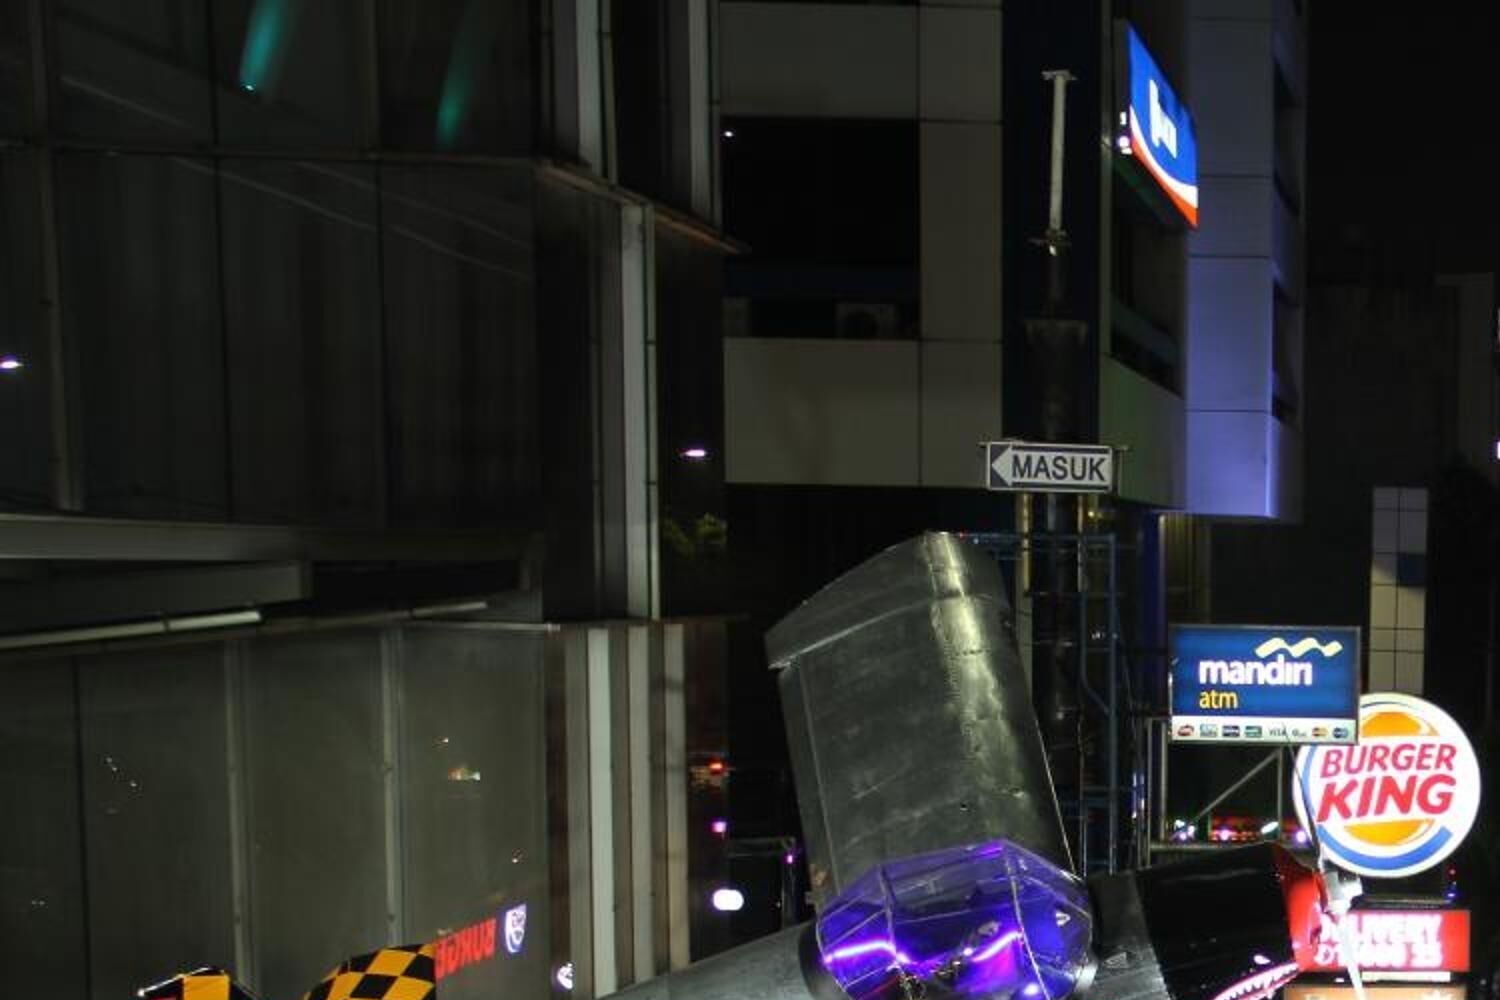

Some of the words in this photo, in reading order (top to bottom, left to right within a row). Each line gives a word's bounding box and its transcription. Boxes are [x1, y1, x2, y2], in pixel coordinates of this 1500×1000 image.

[1012, 455, 1106, 481] MASUK
[1199, 654, 1313, 685] mandiri
[1199, 689, 1239, 709] atm
[1321, 743, 1457, 778] BURGER
[1317, 774, 1457, 823] KING
[1320, 913, 1442, 944] LIVERY
